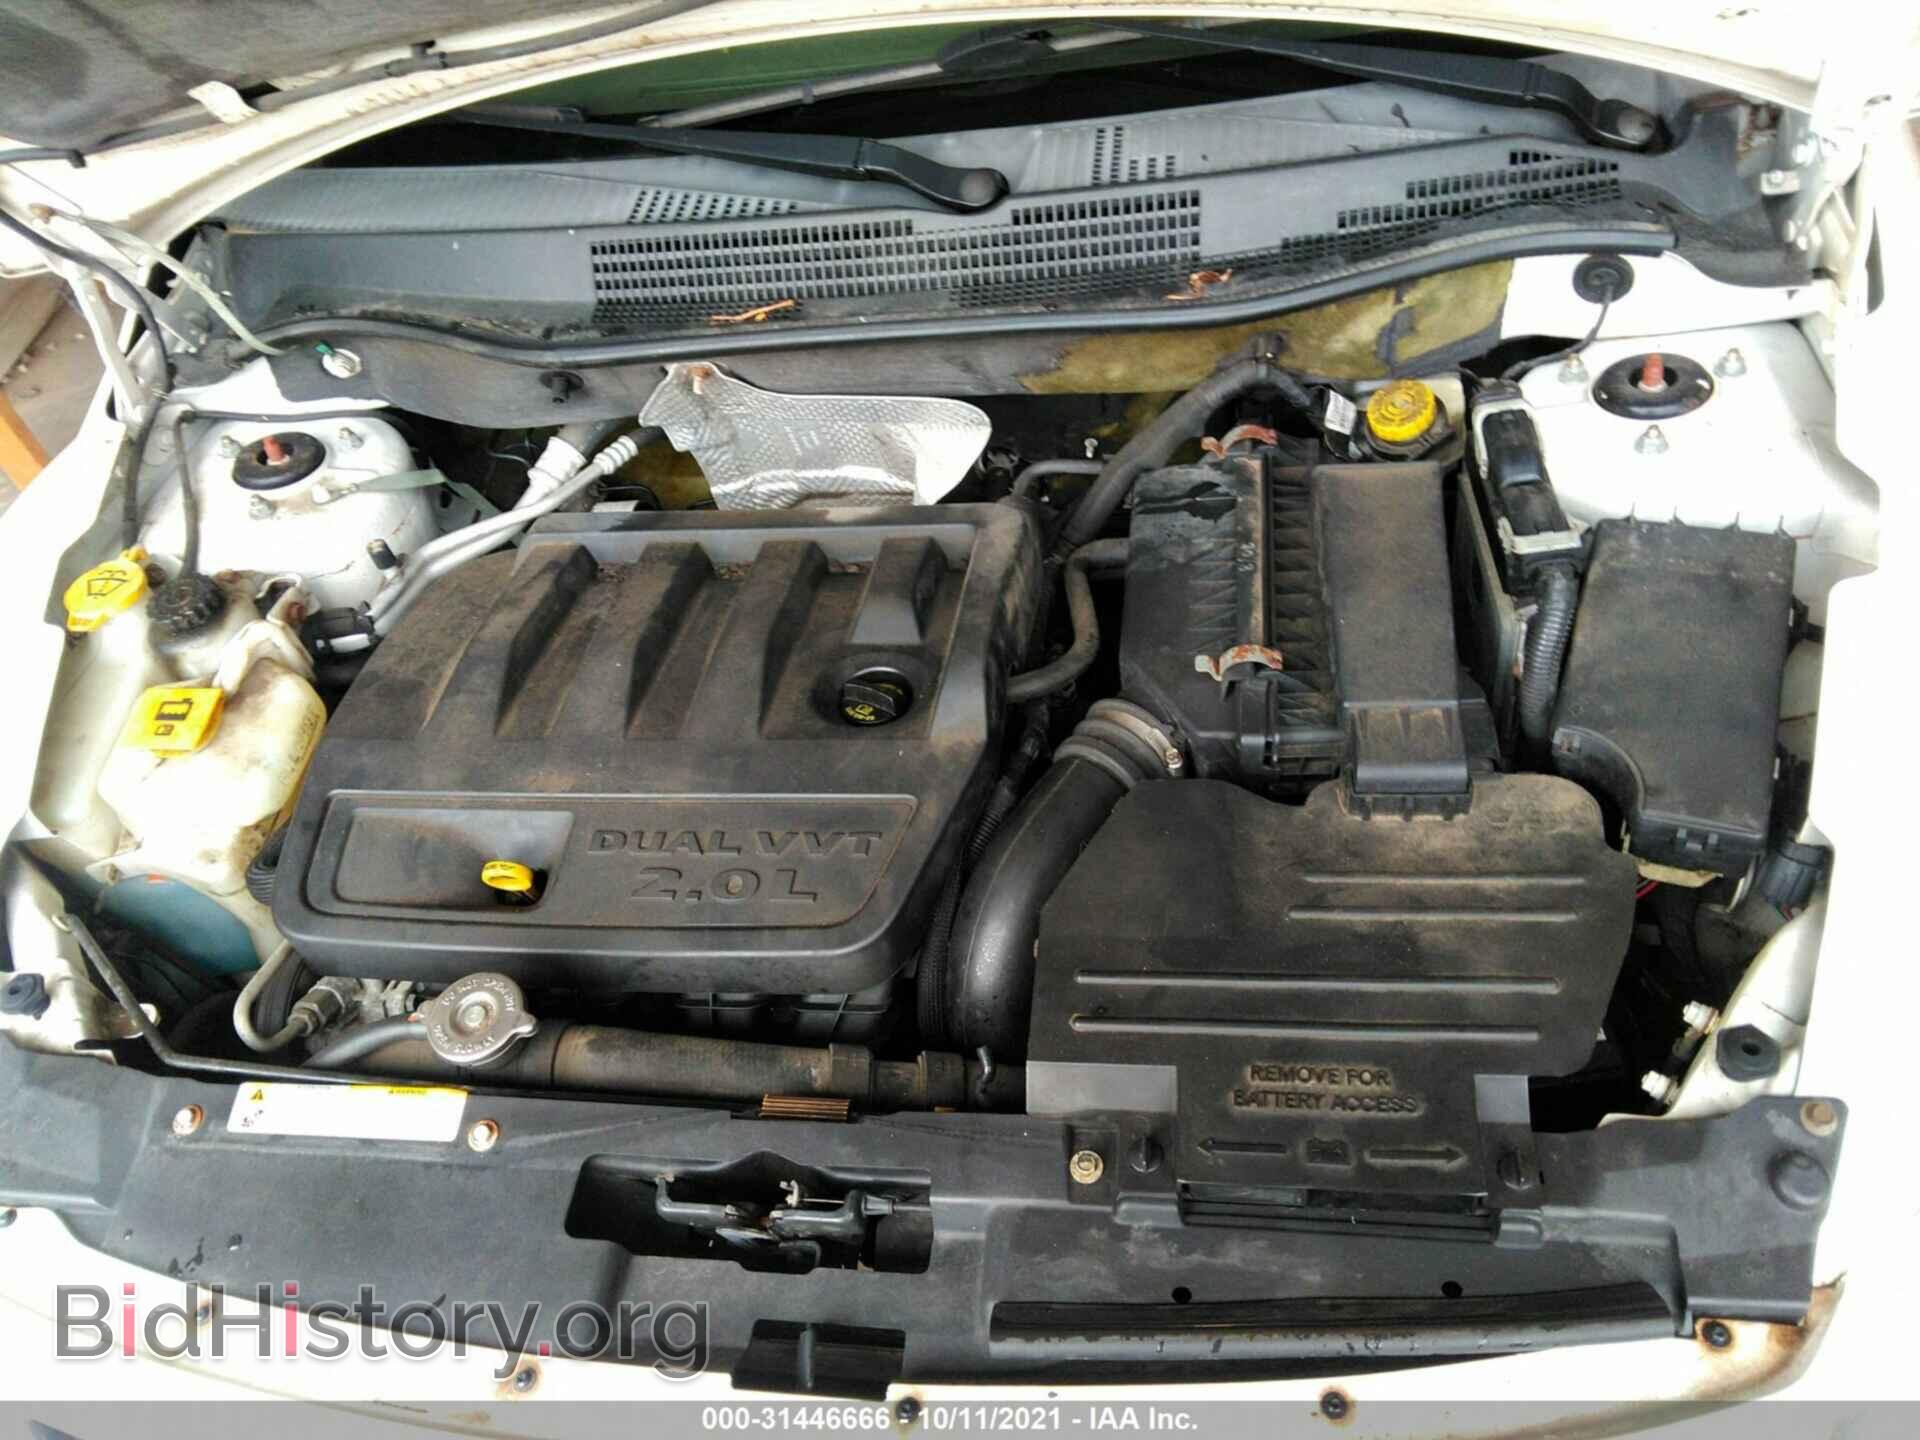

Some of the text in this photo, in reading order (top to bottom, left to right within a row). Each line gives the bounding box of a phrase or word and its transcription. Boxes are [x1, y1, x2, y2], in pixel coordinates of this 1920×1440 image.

[588, 829, 883, 857] DUAL VVT
[631, 866, 818, 903] 2.0L
[1250, 1064, 1392, 1086] REMOVE FOR
[1233, 1088, 1418, 1113] BATTERY ACCESS
